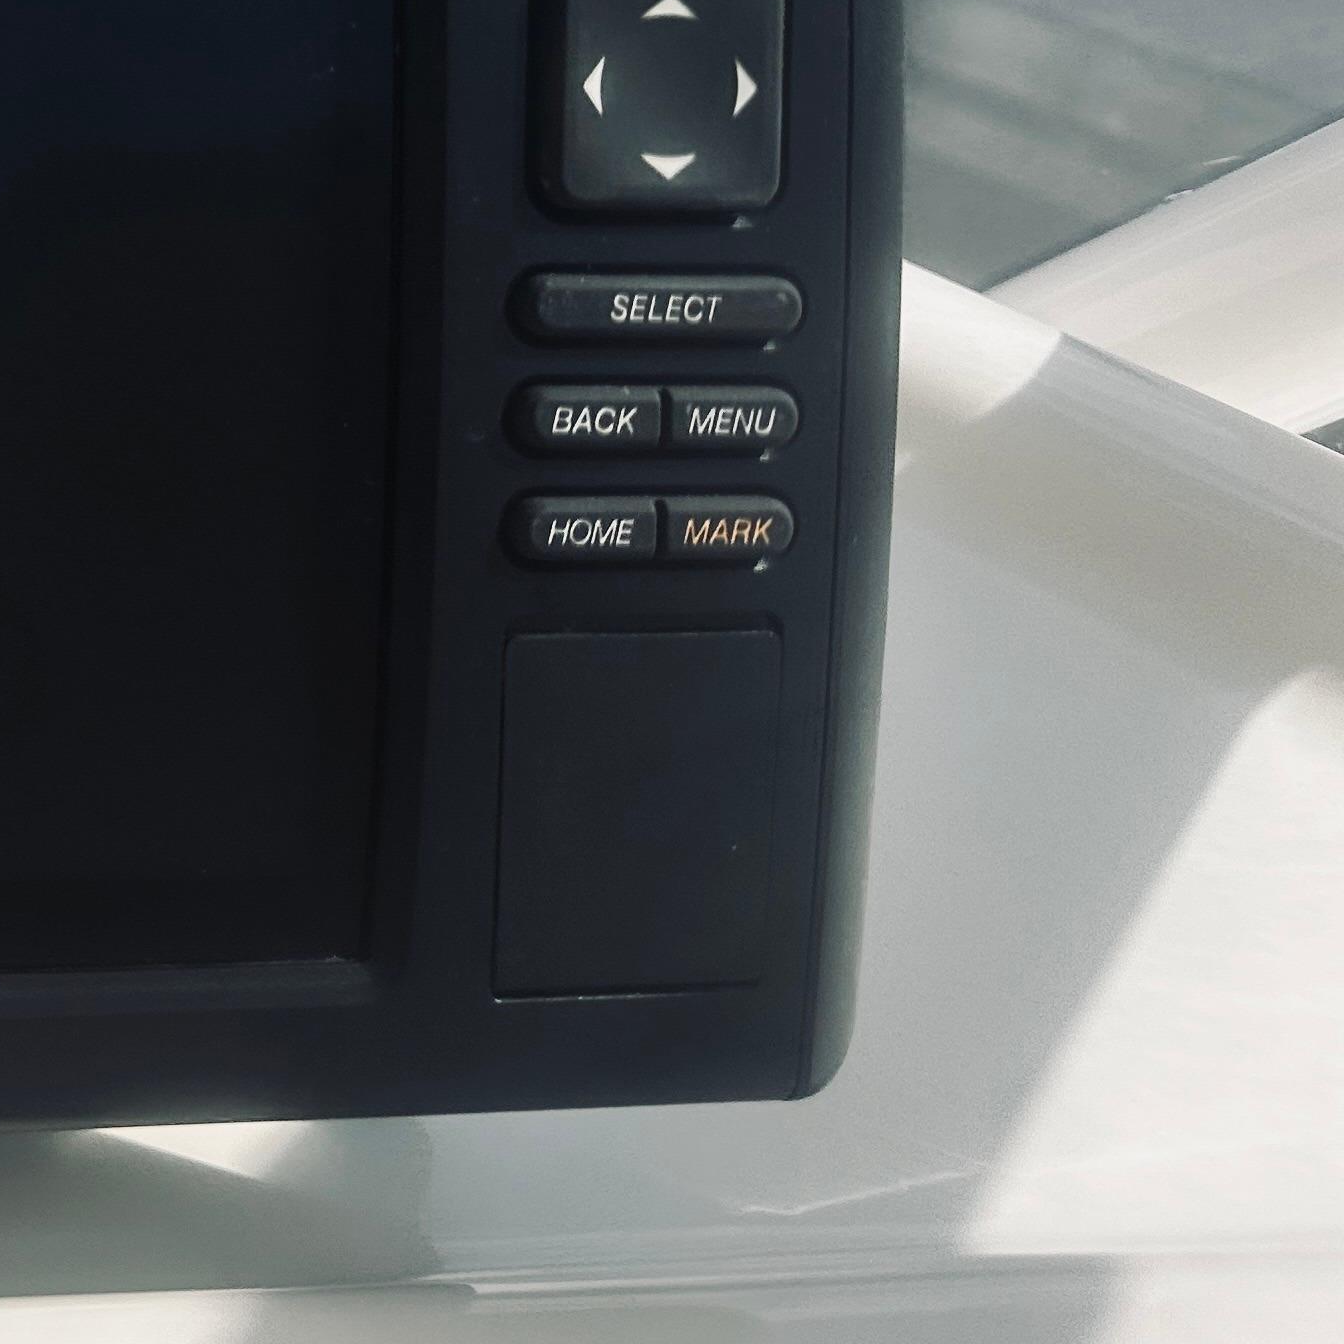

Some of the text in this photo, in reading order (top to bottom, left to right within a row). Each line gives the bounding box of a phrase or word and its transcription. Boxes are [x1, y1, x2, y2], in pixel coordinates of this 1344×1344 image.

[610, 294, 723, 323] SELECT
[551, 406, 638, 435] BACK
[688, 406, 777, 435] MENU
[547, 518, 635, 546] HOME
[683, 517, 773, 545] MARK
